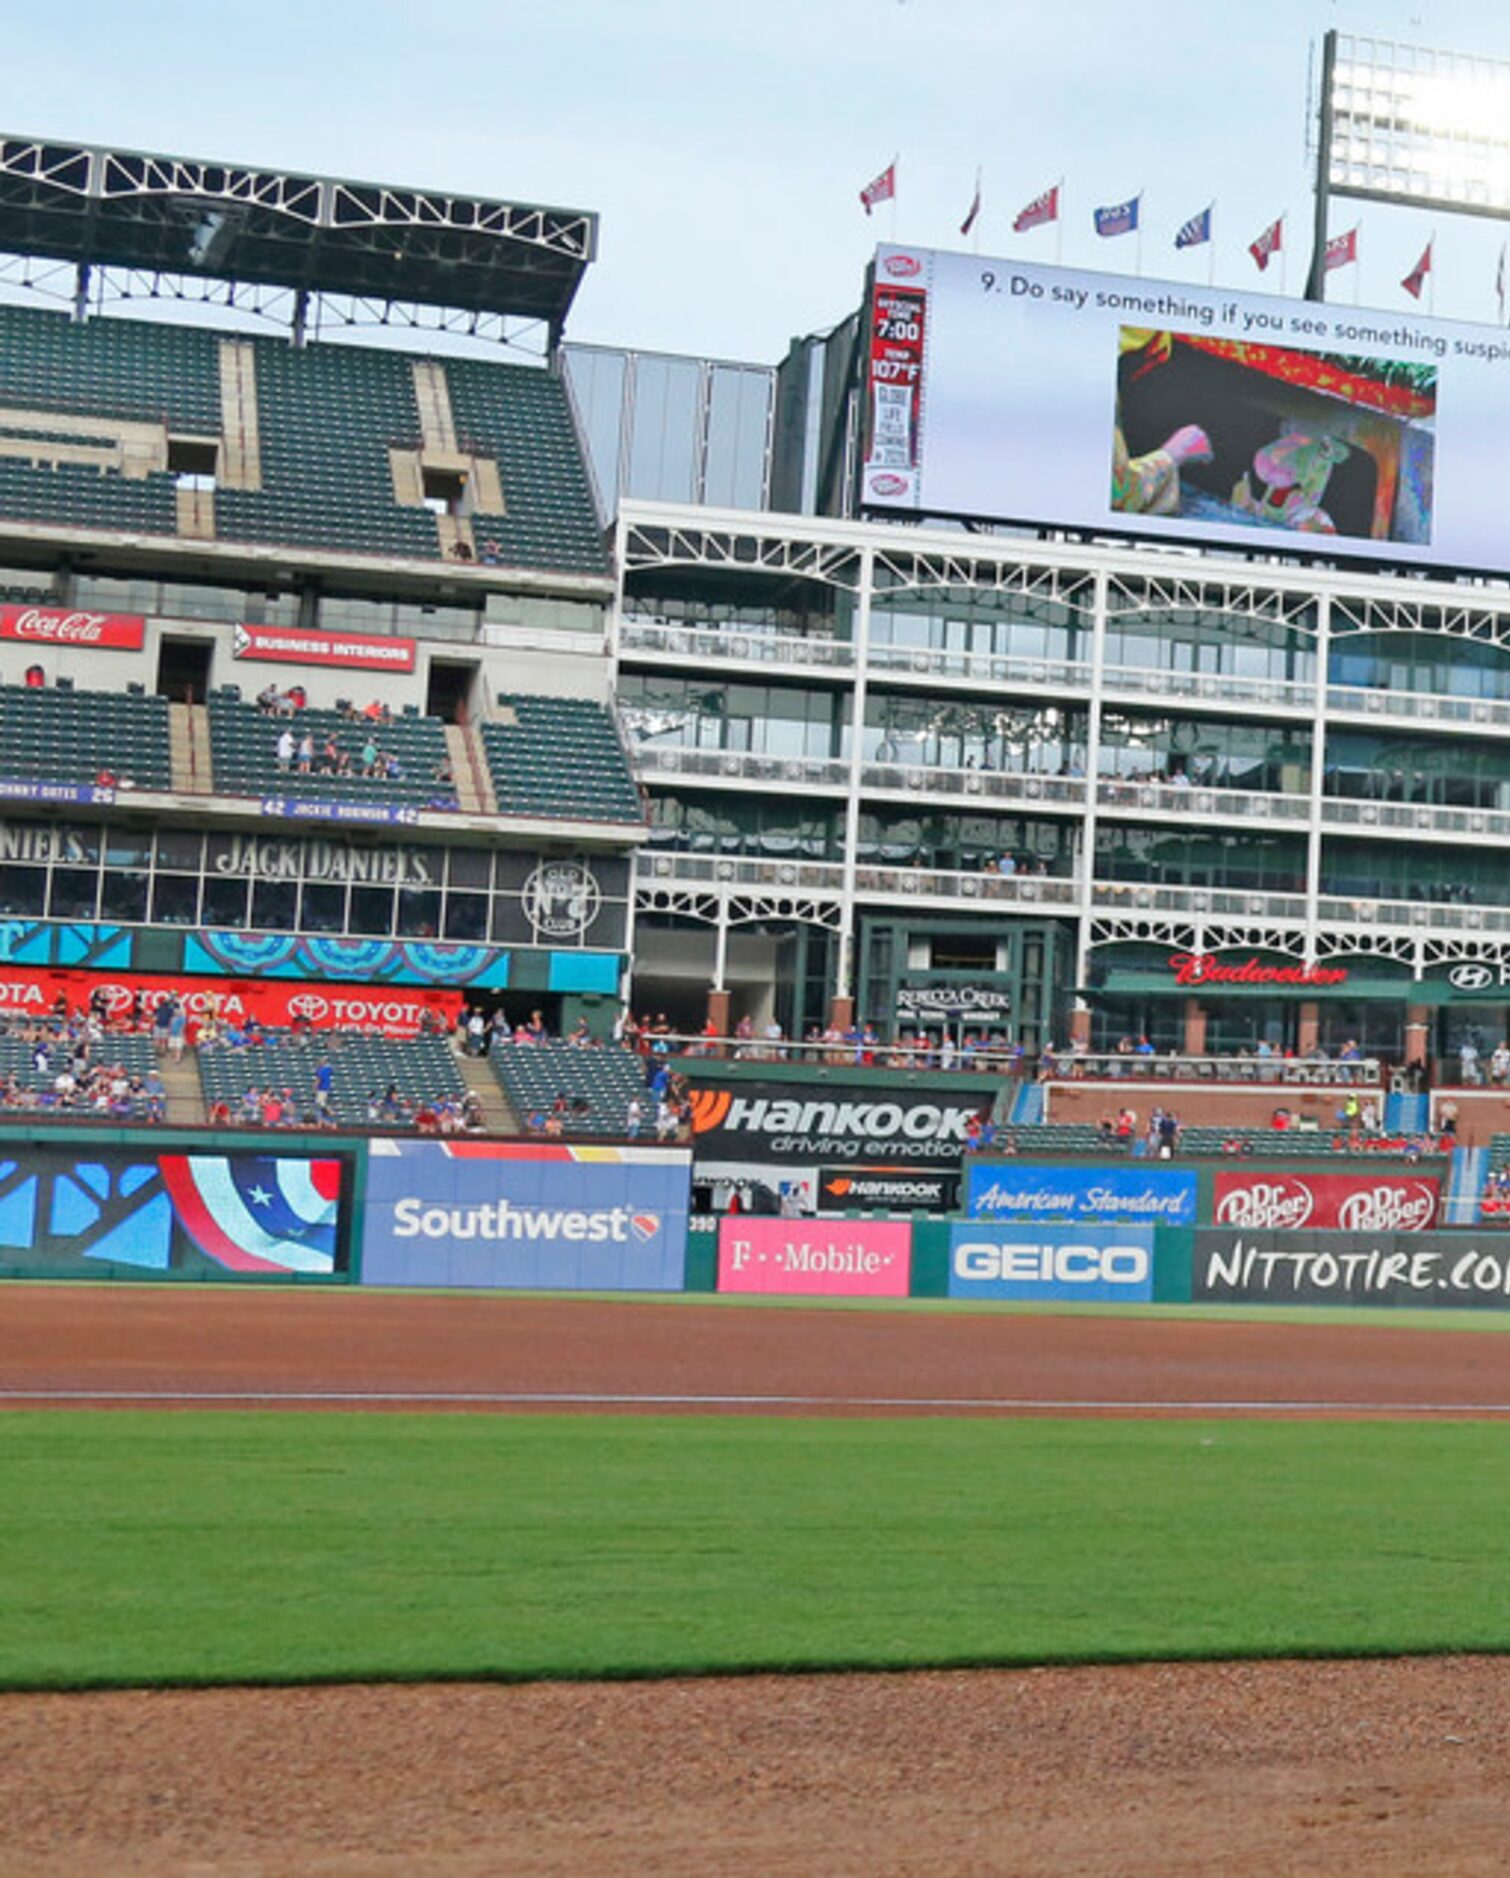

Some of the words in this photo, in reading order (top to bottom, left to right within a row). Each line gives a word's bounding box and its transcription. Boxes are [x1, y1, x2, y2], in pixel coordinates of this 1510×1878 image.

[878, 318, 920, 341] 7:00
[981, 273, 1001, 294] 9.
[1010, 276, 1044, 298] Do
[1051, 287, 1089, 310] say
[1096, 289, 1215, 326] something
[1222, 302, 1238, 324] if
[1243, 311, 1284, 332] you
[1290, 316, 1328, 335] see
[1334, 322, 1447, 357] something
[255, 635, 330, 655] BUSINESS
[332, 641, 409, 661] INTERIORS
[264, 799, 286, 815] 42
[395, 808, 419, 824] 42
[216, 835, 299, 882] JACK
[1169, 953, 1348, 985] Budweiser
[771, 1135, 860, 1157] driving
[975, 1183, 1076, 1211] American
[1079, 1186, 1187, 1213] Standard
[1220, 1189, 1306, 1229] Pepper
[1251, 1183, 1286, 1208] Dr
[1373, 1186, 1408, 1211] Dr
[393, 1196, 629, 1242] Southwest
[1341, 1192, 1428, 1231] Pepper
[953, 1243, 1150, 1284] GEICO
